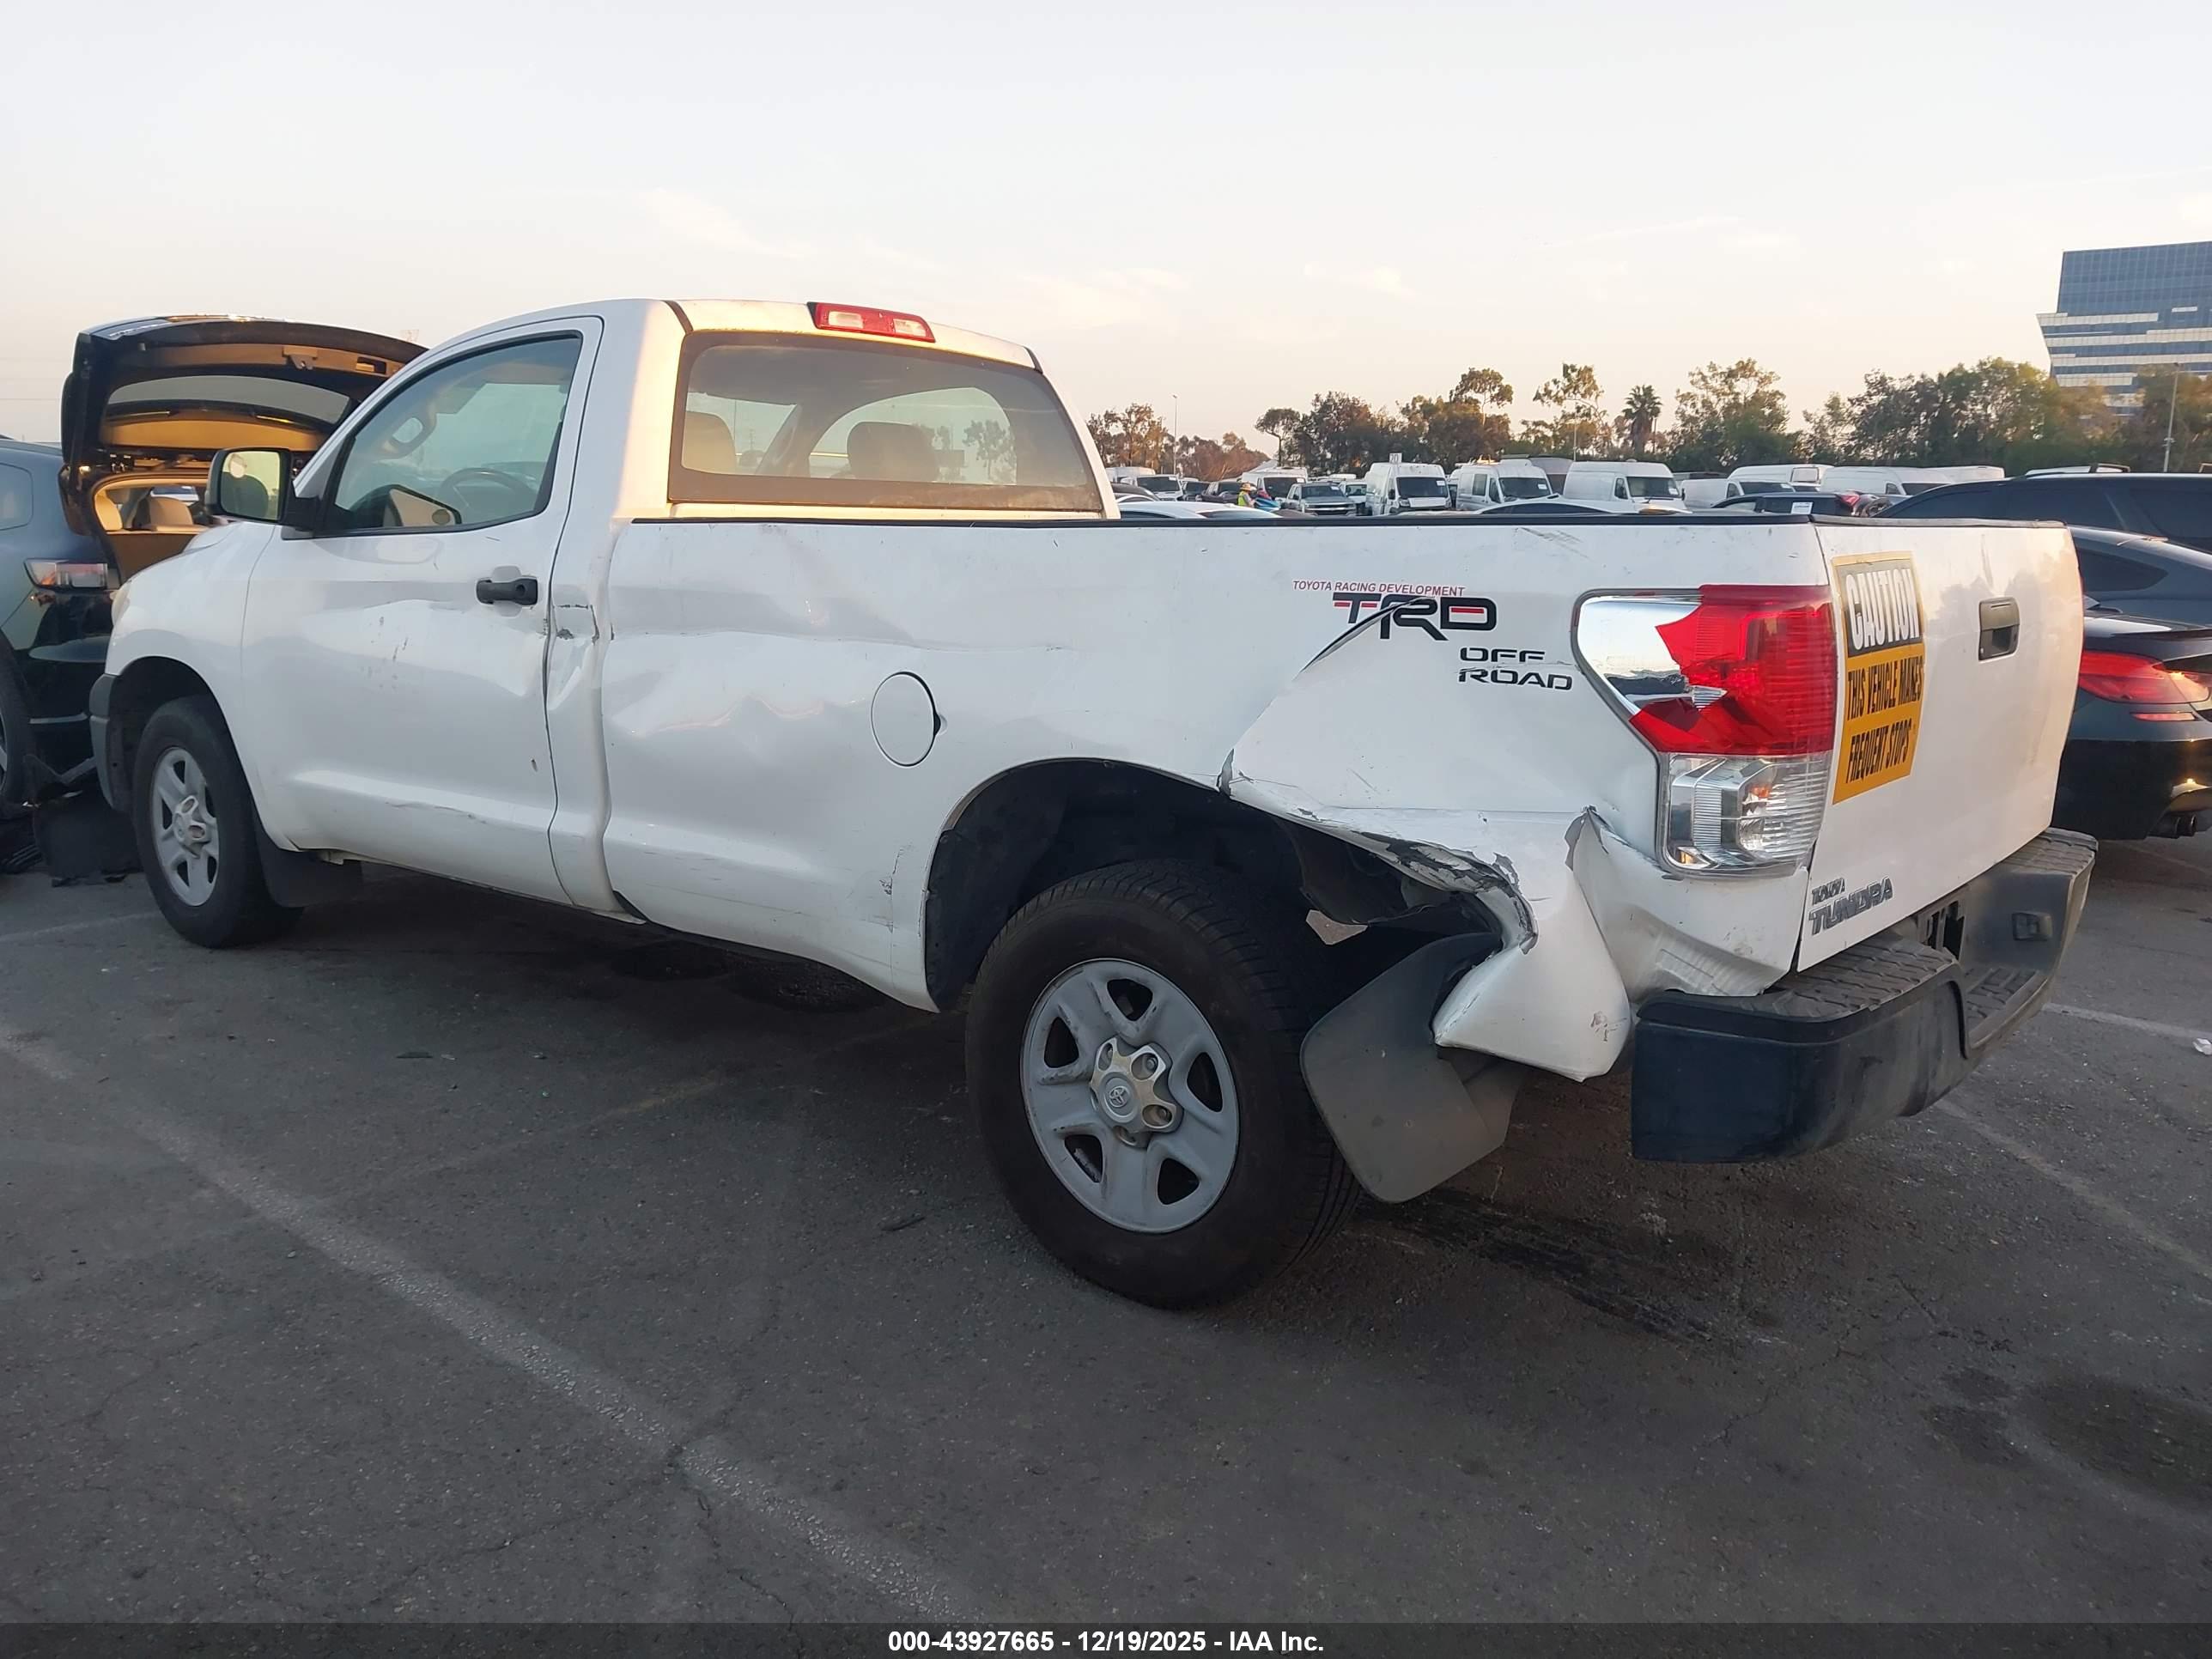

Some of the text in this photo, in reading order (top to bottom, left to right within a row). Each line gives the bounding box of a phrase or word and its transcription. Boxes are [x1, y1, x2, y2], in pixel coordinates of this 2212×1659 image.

[1292, 580, 1466, 597] TOYOTA RACING DEVELOPMENT
[1846, 568, 1920, 651] CAUTION
[1332, 592, 1498, 641] TRD
[1458, 668, 1573, 691] ROAD
[1460, 647, 1546, 663] OFF
[1846, 655, 1923, 721] THIS VEHICLE MAKES
[1846, 718, 1912, 784] FREQUENT STOPS
[1808, 876, 1893, 936] TUNDRA
